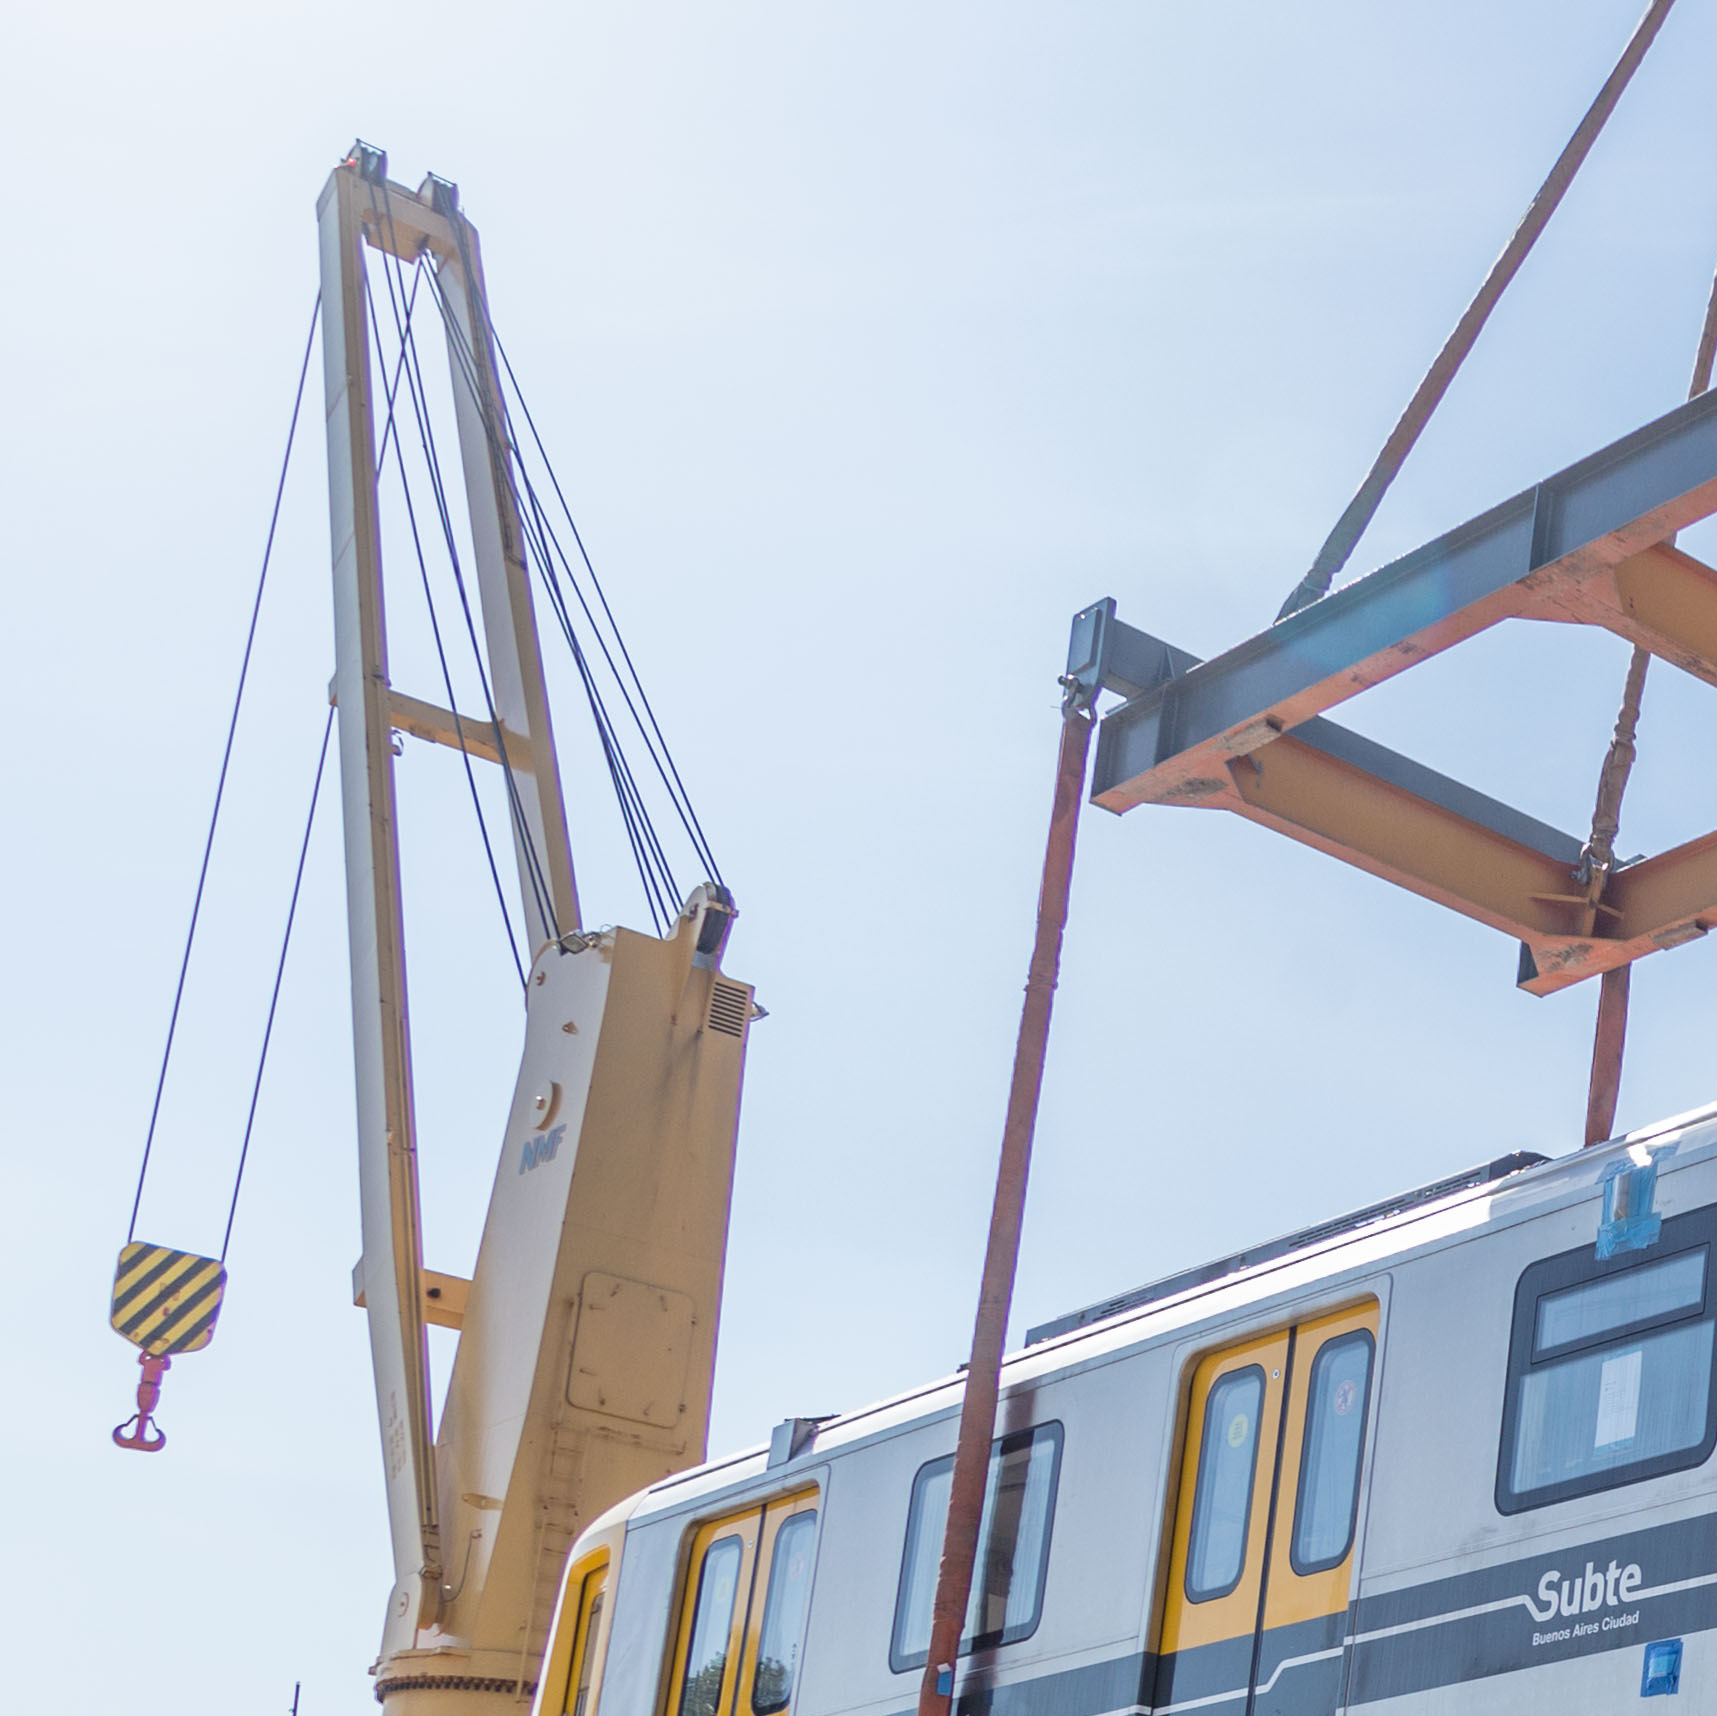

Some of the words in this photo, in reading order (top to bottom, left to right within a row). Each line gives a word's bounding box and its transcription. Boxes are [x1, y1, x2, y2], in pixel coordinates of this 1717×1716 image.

[519, 1123, 567, 1175] NMF
[1536, 1559, 1643, 1622] Subte
[1532, 1626, 1571, 1646] Buenos
[1573, 1620, 1599, 1637] Aires
[1602, 1611, 1640, 1632] Ciudad
